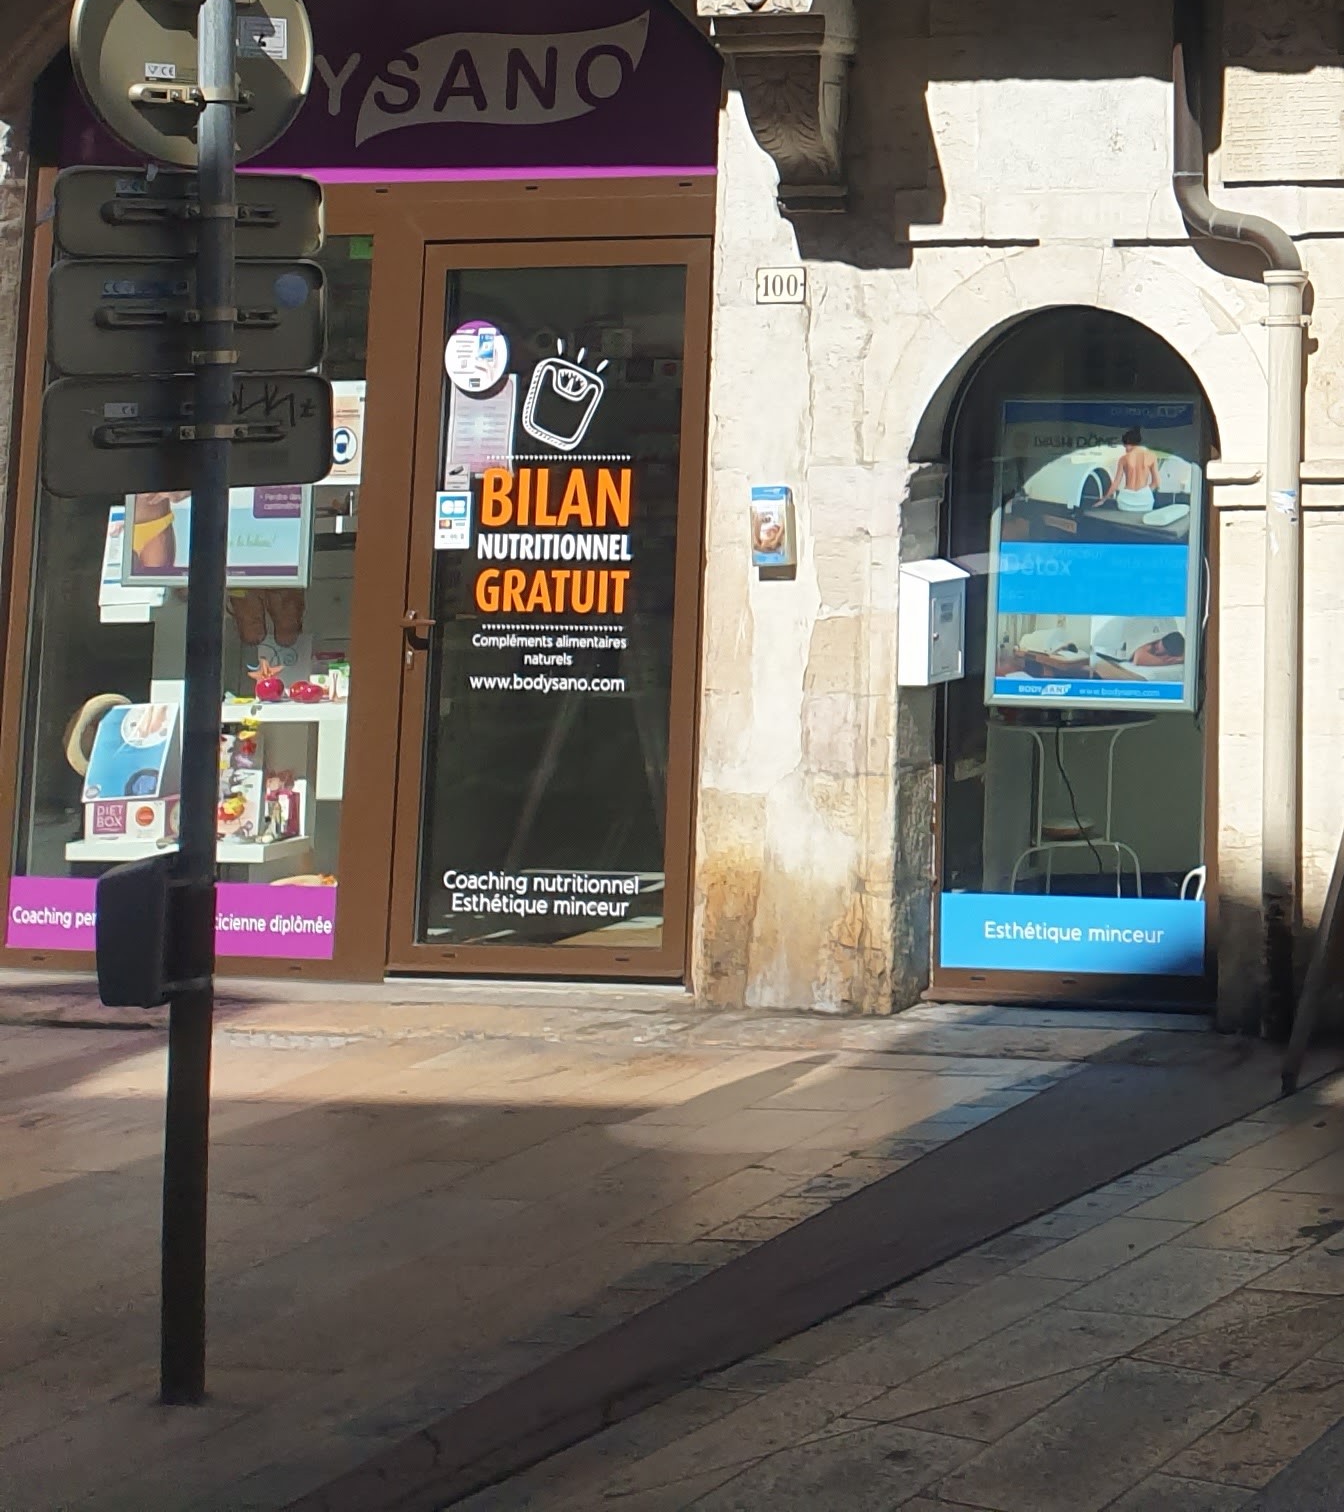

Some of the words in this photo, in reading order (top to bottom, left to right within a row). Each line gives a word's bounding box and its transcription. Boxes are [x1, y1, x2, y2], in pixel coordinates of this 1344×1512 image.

[311, 44, 634, 116] YSANO
[762, 273, 799, 297] 100
[480, 467, 632, 527] BILAN
[476, 532, 633, 561] NUTRITIONNEL
[475, 568, 631, 614] GRATUIT
[471, 633, 553, 650] Compléments
[555, 634, 628, 649] alimentaires
[523, 652, 573, 666] naturels
[469, 673, 626, 694] www.bodysano.com
[96, 805, 124, 817] DIET
[96, 815, 123, 828] BOX
[443, 870, 528, 895] Coaching
[533, 874, 640, 895] nutritionnel
[451, 892, 549, 917] Esthétique
[553, 896, 630, 917] minceur
[12, 906, 72, 929] Coaching
[269, 914, 333, 935] diplômée
[983, 920, 1083, 944] Esthétique
[1088, 925, 1165, 944] minceur
